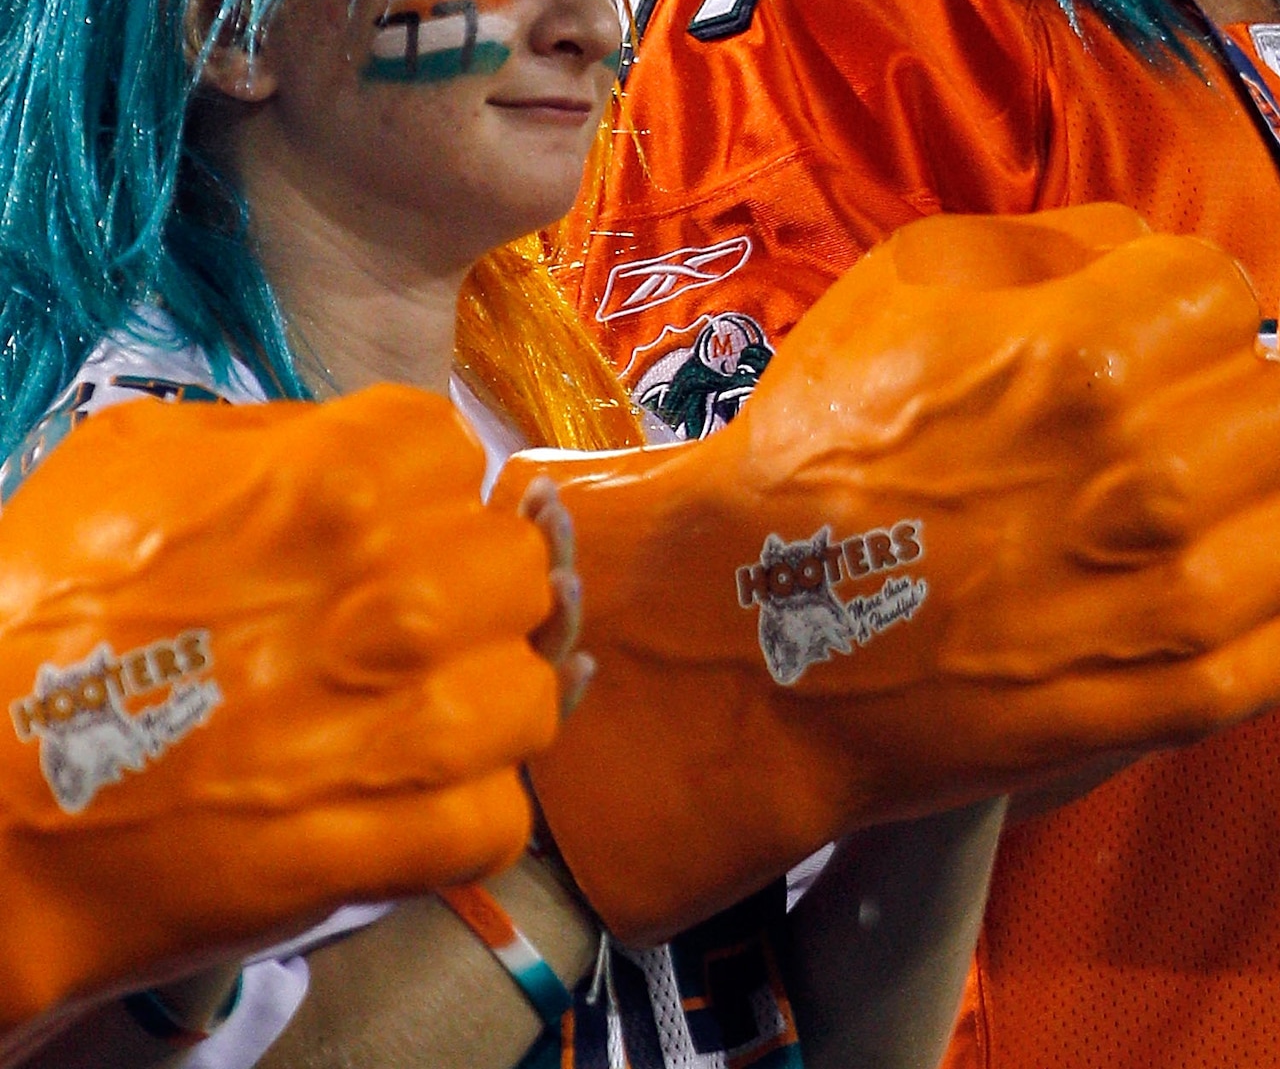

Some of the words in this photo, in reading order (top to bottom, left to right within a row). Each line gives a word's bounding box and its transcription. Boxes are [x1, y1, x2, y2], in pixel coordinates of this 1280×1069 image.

[711, 335, 734, 358] M
[738, 524, 922, 606] HOOTERS
[18, 633, 208, 734] HOOTERS
